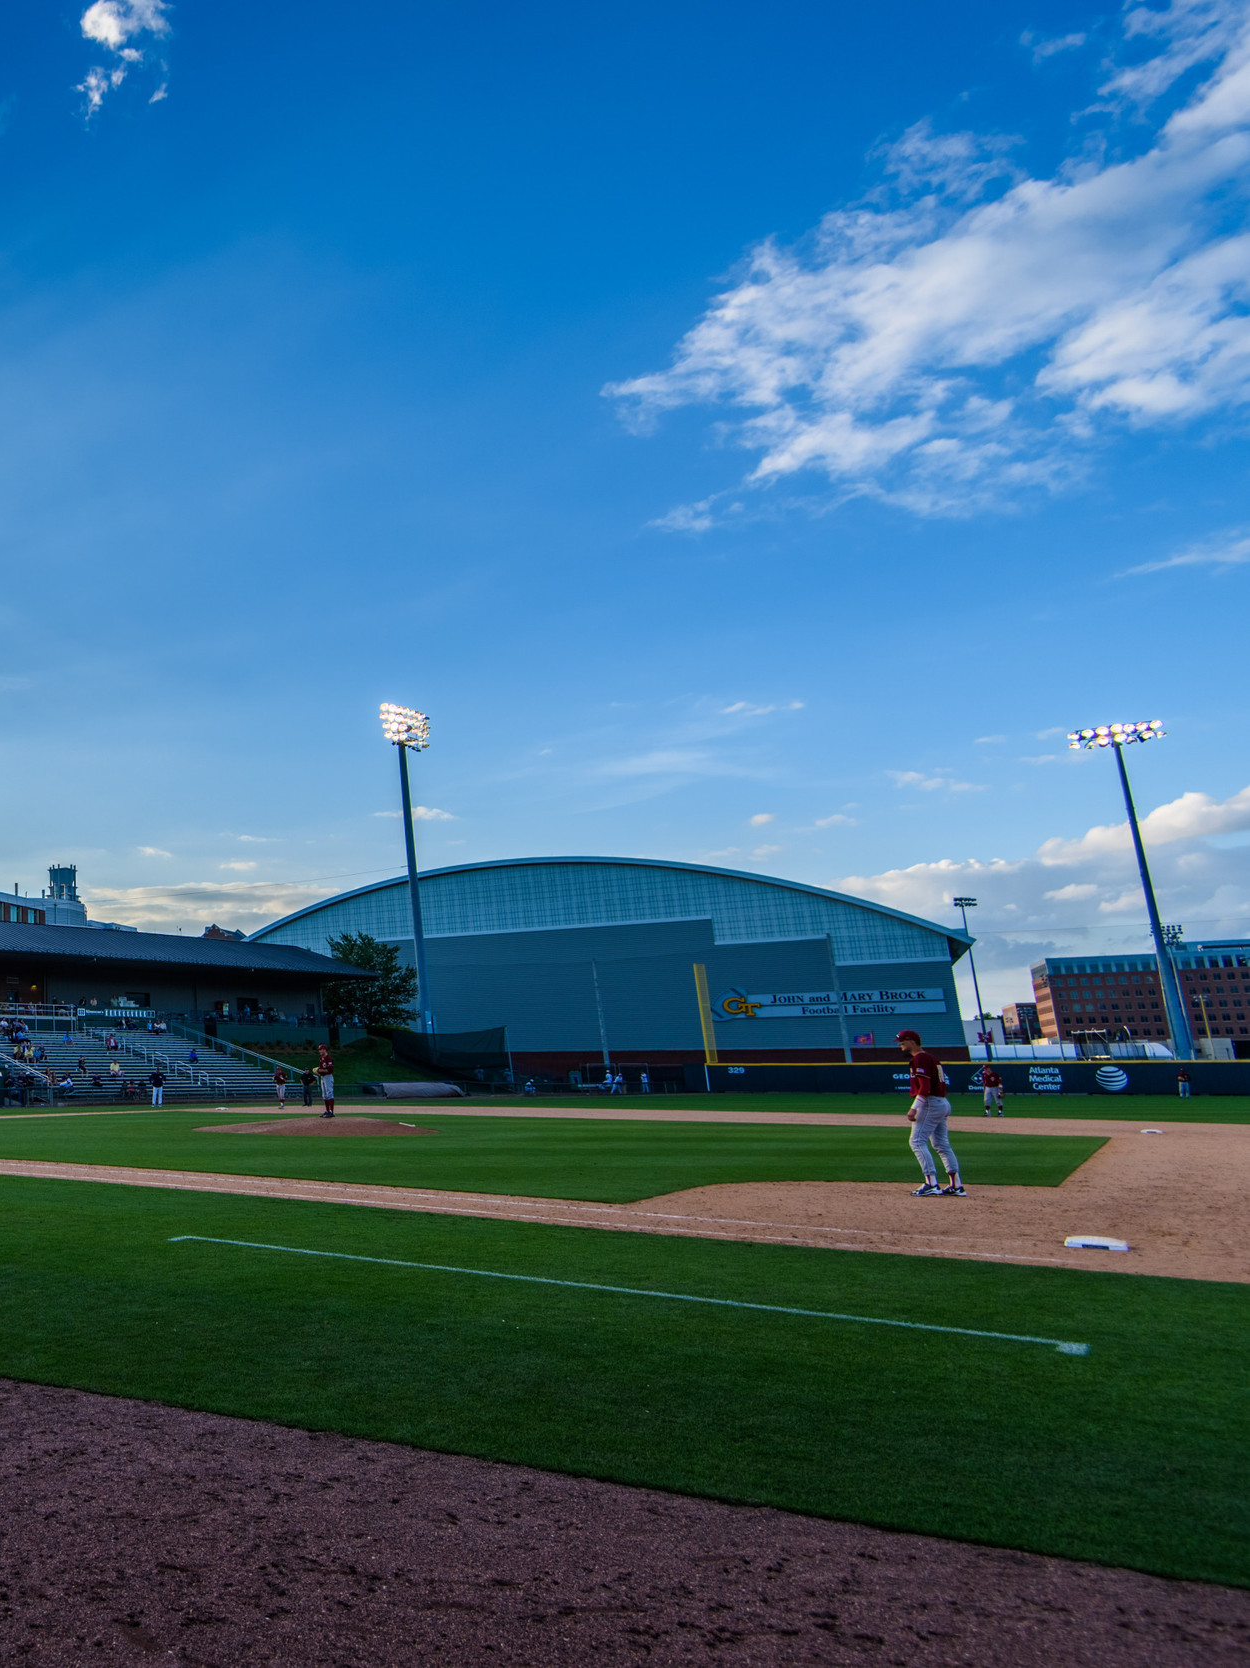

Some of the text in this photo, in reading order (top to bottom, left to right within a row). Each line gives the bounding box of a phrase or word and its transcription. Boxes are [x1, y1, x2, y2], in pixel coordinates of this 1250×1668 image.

[770, 994, 804, 1003] JOHN
[809, 994, 830, 1002] and
[879, 990, 926, 1000] BROCK
[723, 996, 761, 1016] GT
[852, 1004, 896, 1015] Facility
[727, 1066, 745, 1074] 329
[1029, 1066, 1060, 1074] Atlanta
[1029, 1074, 1062, 1083] Medical
[1032, 1082, 1061, 1091] Center
